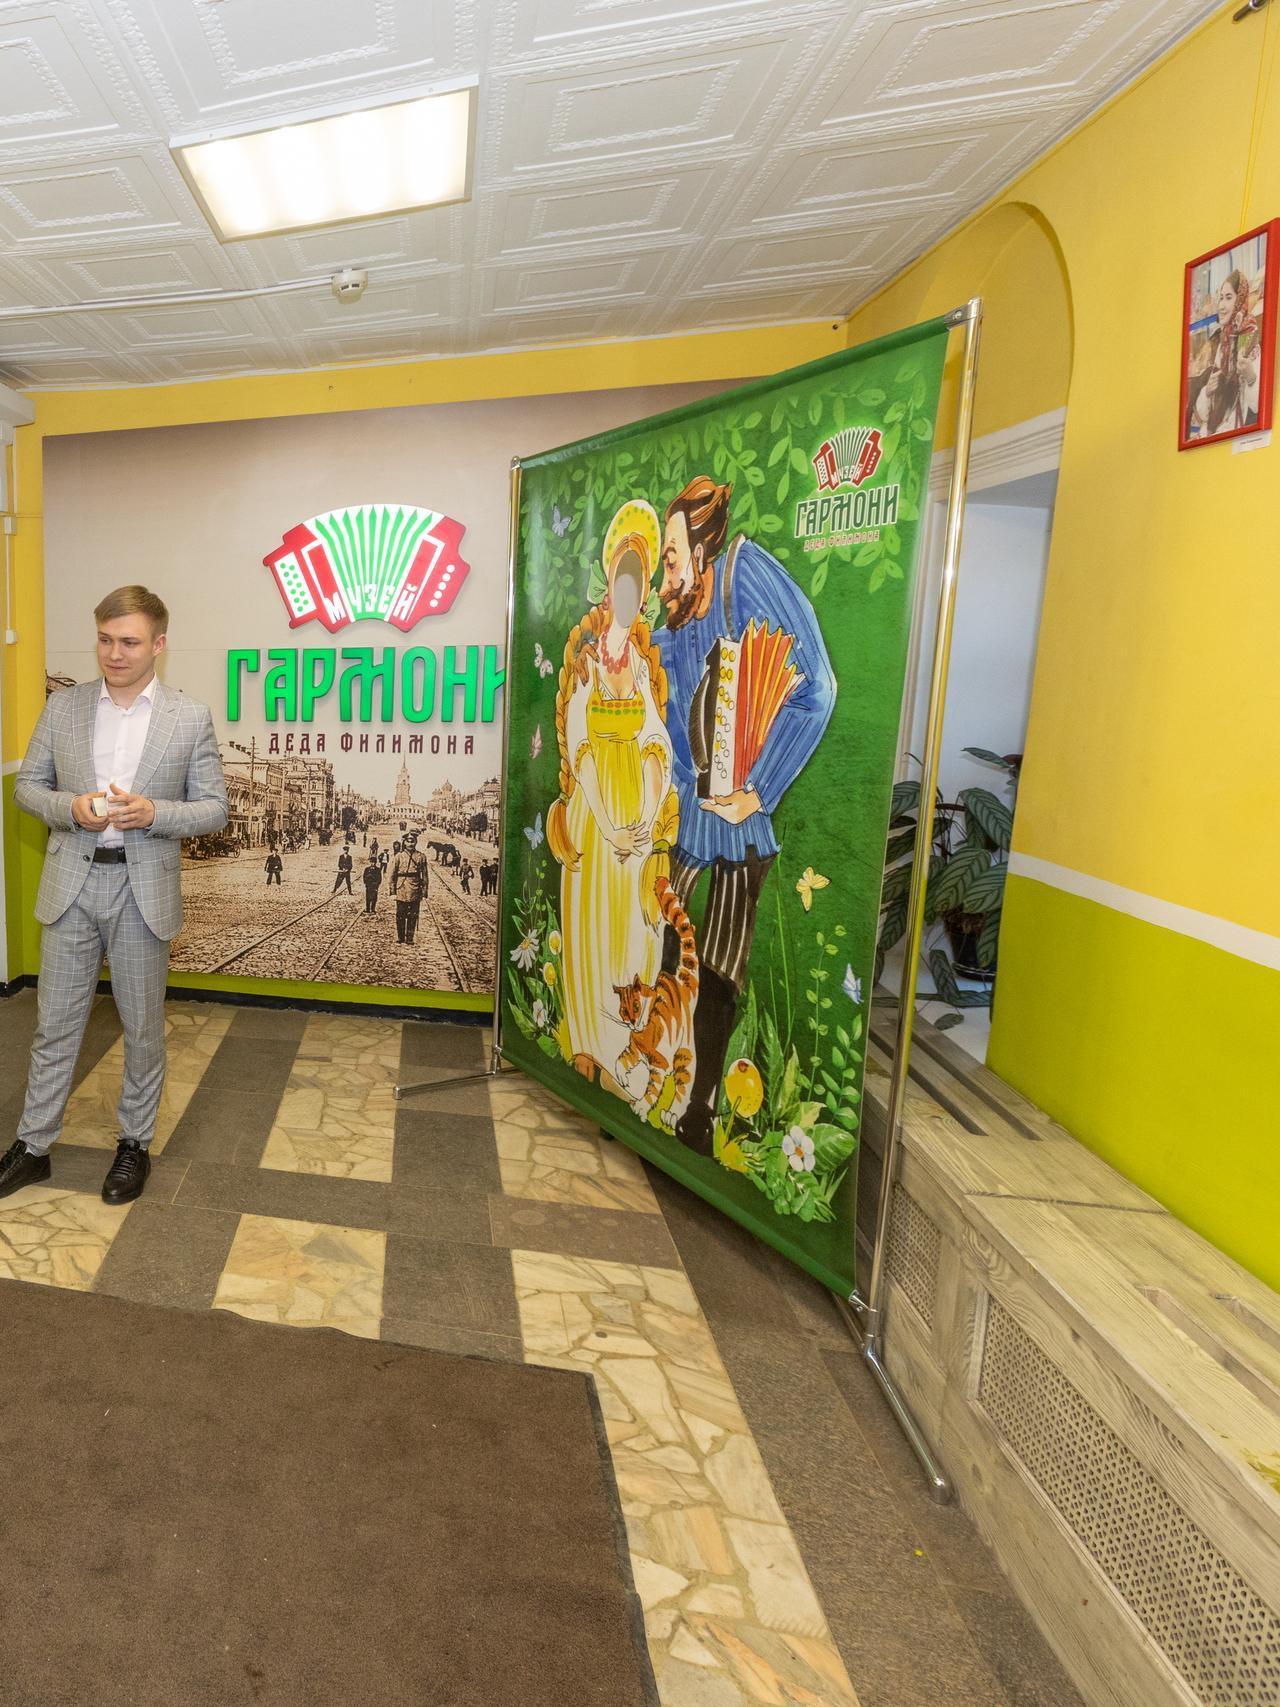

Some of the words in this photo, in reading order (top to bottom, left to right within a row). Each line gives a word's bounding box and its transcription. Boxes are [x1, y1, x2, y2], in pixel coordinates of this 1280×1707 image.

[831, 463, 863, 486] МУЗЕЙ
[795, 484, 900, 538] ГАРМОНИ
[323, 583, 418, 624] МУЗЕЙ
[268, 733, 326, 755] ДЕДА
[340, 732, 474, 755] ФИЛИМОНА
